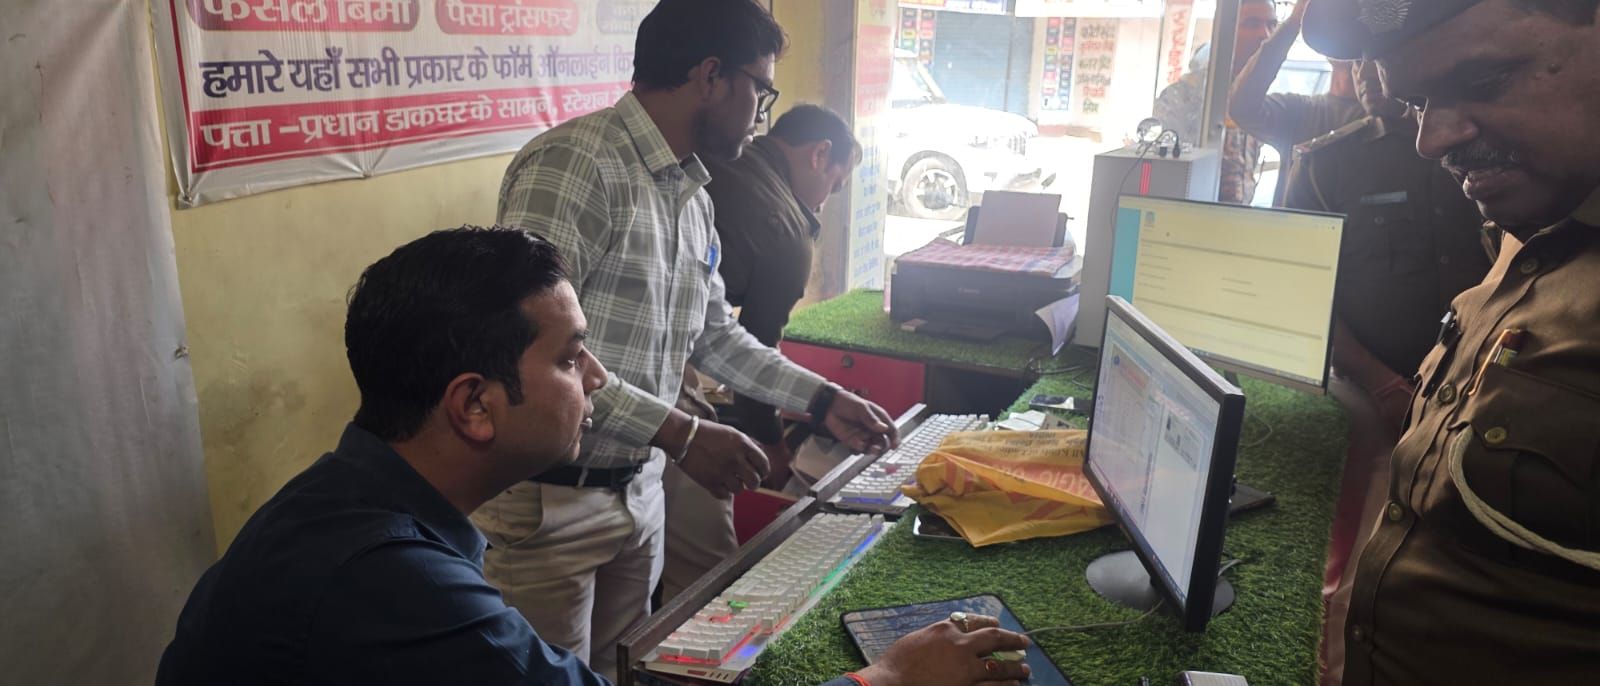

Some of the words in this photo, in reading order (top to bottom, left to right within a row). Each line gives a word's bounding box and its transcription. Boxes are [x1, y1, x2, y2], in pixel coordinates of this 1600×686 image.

[199, 50, 284, 98] हमारे
[288, 47, 343, 92] यहाँ
[345, 46, 400, 89] सभी
[404, 54, 465, 88] प्रकार
[467, 46, 489, 81] के
[492, 45, 533, 79] फॉर्म
[200, 119, 272, 150] पत्ता
[1040, 470, 1091, 496] AGIC
